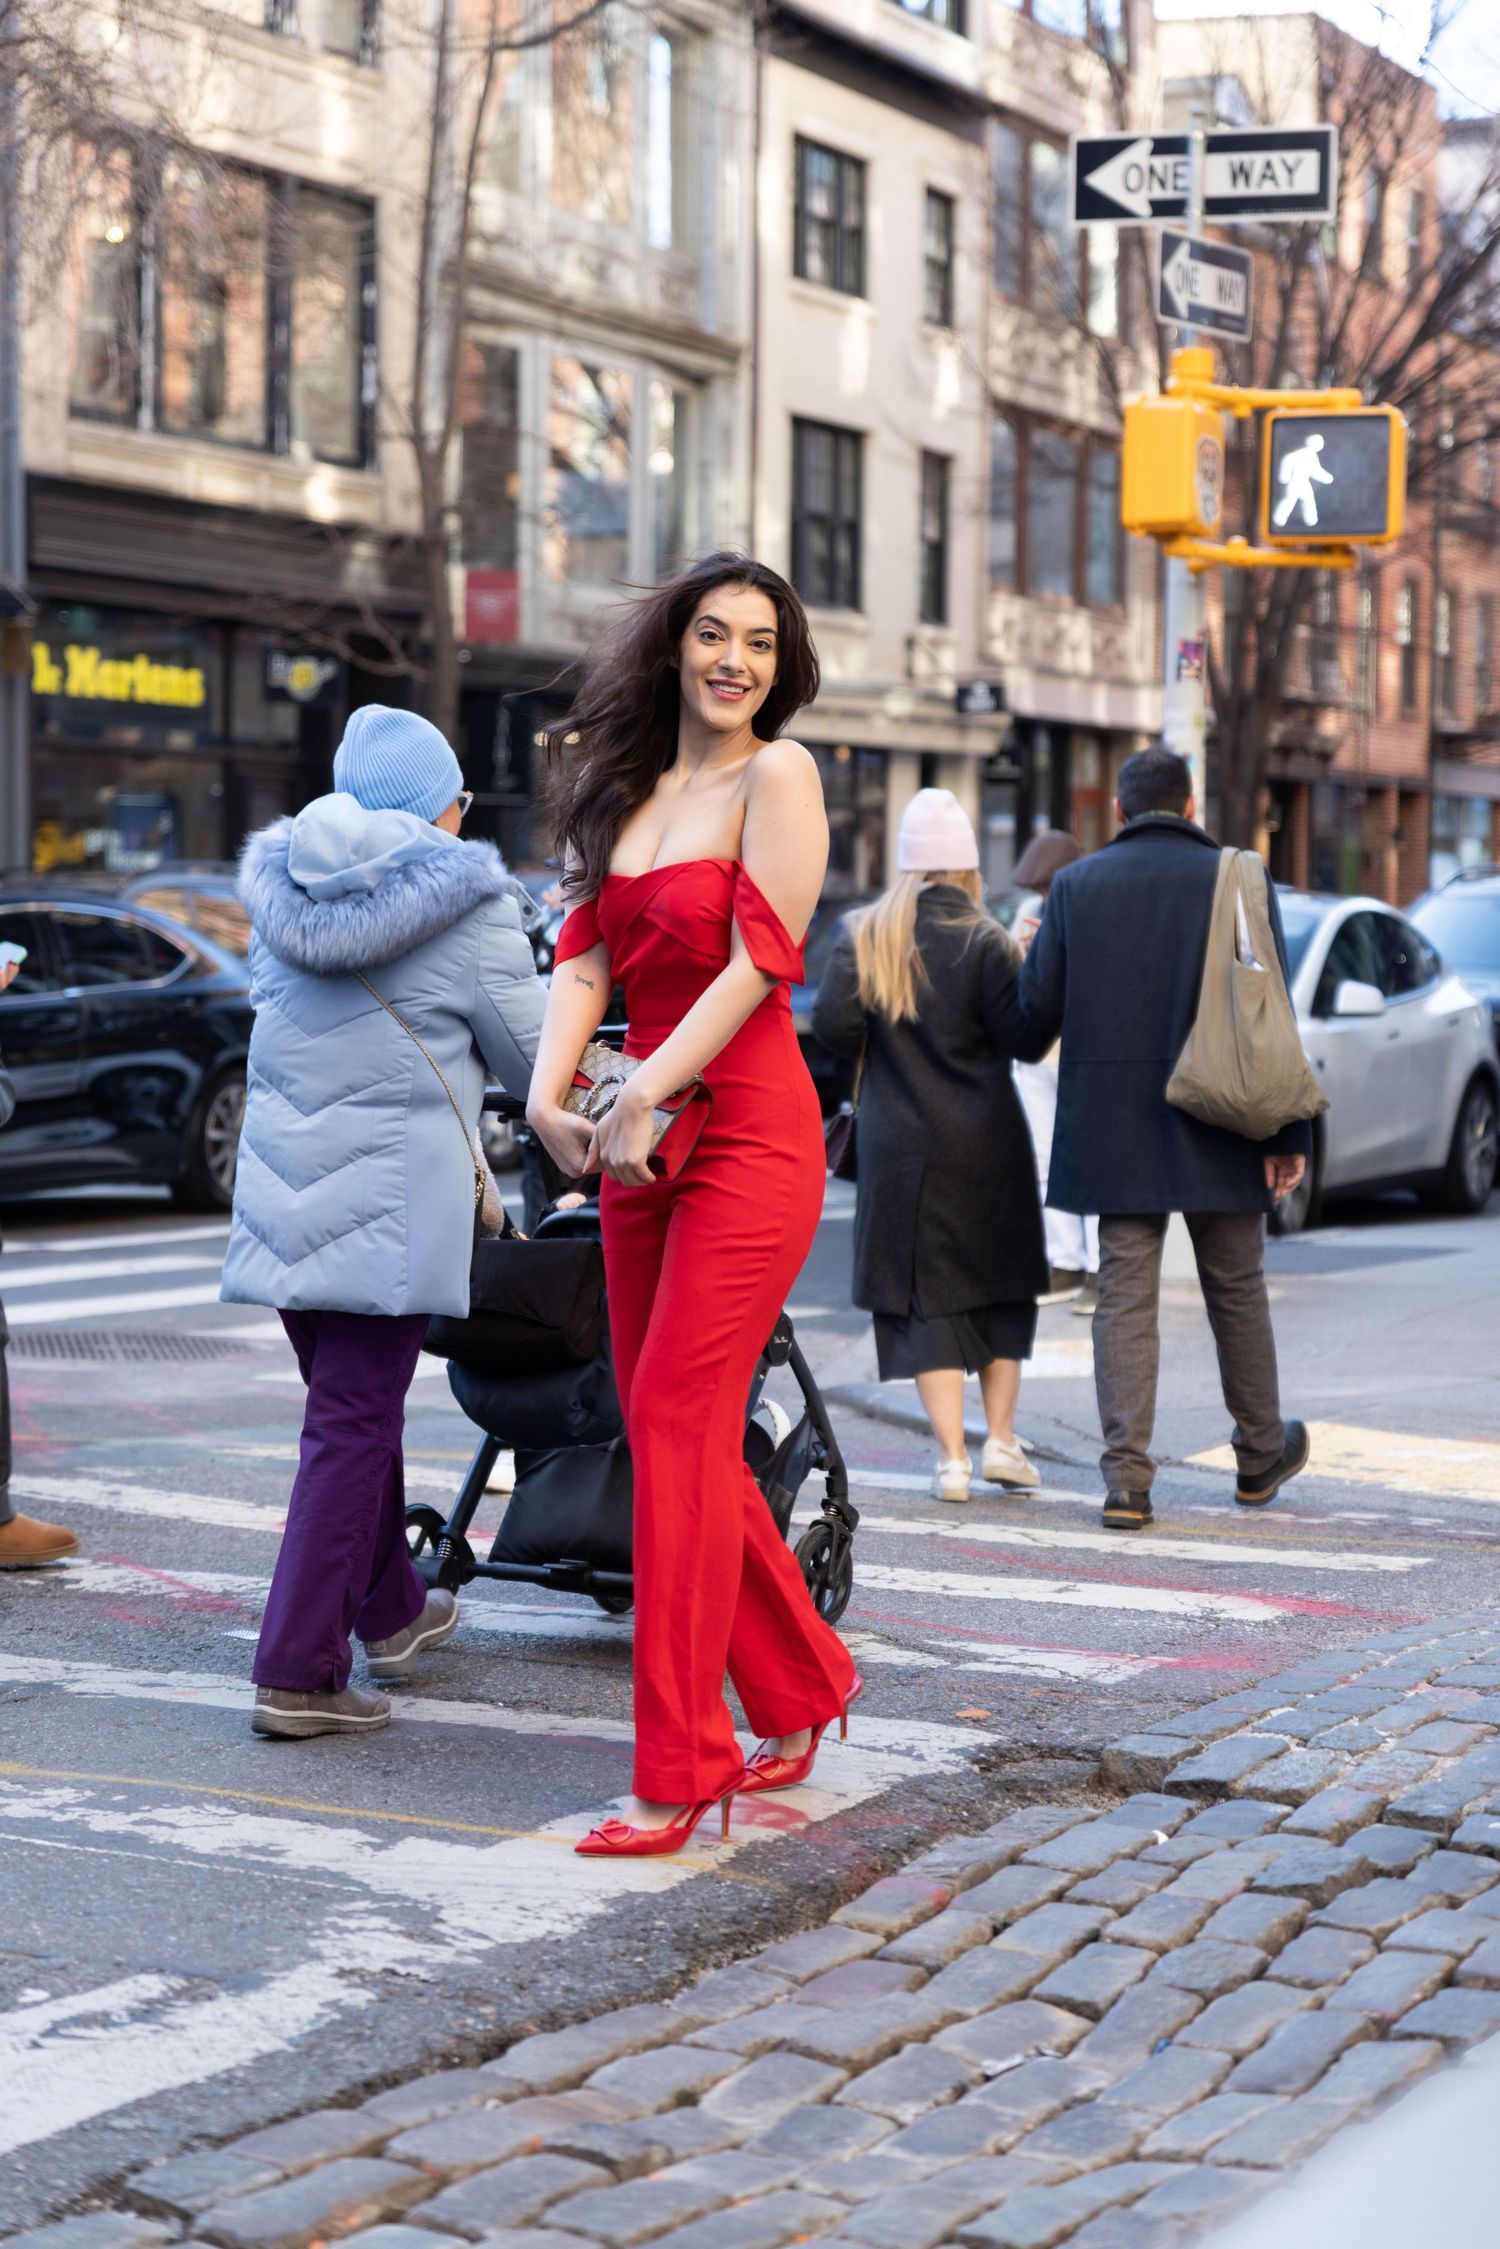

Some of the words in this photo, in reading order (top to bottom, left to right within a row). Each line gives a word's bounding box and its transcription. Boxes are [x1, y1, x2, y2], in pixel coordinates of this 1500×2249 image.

[1123, 159, 1189, 194] ONE
[1229, 157, 1304, 191] WAY
[1175, 261, 1199, 298] ONE
[1217, 271, 1245, 308] WAY
[64, 644, 206, 708] Martens
